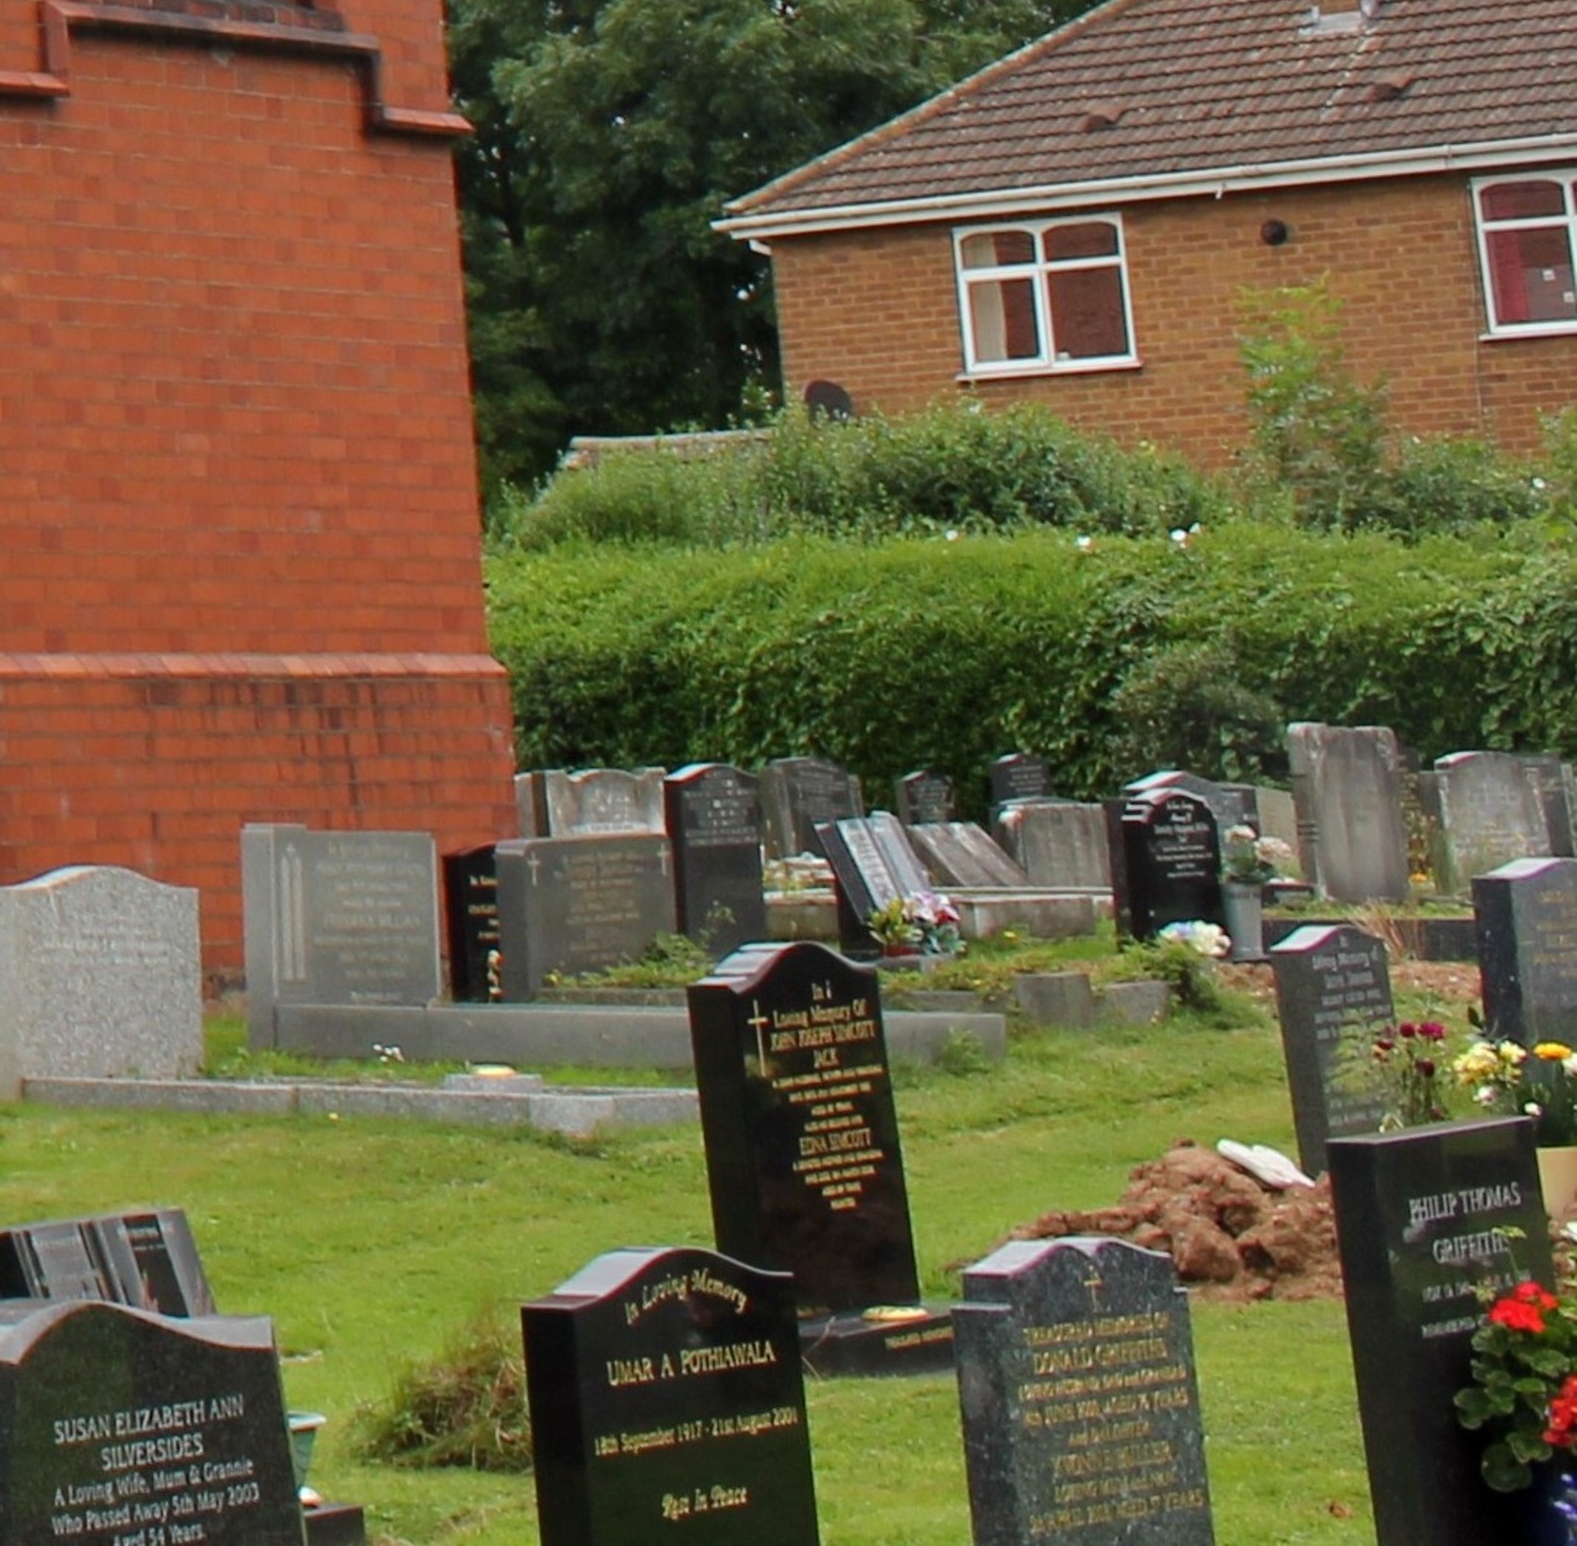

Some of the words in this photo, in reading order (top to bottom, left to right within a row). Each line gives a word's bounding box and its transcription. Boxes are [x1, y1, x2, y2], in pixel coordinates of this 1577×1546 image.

[773, 1010, 809, 1029] Loving
[811, 1005, 851, 1025] Memory
[799, 1026, 833, 1048] JOSEPH
[813, 1049, 840, 1069] JACK
[1409, 1192, 1458, 1224] PHILIP
[1459, 1181, 1521, 1215] THOMAS
[624, 1302, 640, 1325] In
[642, 1272, 688, 1311] Loving
[690, 1267, 749, 1314] Memory
[607, 1356, 655, 1386] UMAR
[660, 1353, 675, 1379] A
[680, 1339, 776, 1375] POTHIAWALA
[1033, 1346, 1094, 1376] DONALD
[1095, 1337, 1168, 1367] GRIFFITHS
[54, 1414, 111, 1445] SUSAN
[115, 1399, 206, 1436] ELIZABETH
[209, 1393, 245, 1421] ANN
[620, 1426, 675, 1452] September
[678, 1418, 703, 1442] 1917
[711, 1414, 734, 1438] 21st
[736, 1408, 771, 1436] August
[100, 1432, 205, 1471] SILVERSIDES
[53, 1488, 66, 1508] A
[67, 1479, 115, 1504] Loving
[116, 1471, 150, 1497] Wife,
[153, 1469, 187, 1491] Mum
[188, 1467, 202, 1485] &
[202, 1456, 254, 1482] Grannie
[710, 1484, 748, 1509] Peace
[51, 1514, 83, 1536] Who
[85, 1504, 131, 1531] Passed
[133, 1499, 169, 1524] Away
[197, 1491, 226, 1514] May
[227, 1482, 261, 1506] 2003
